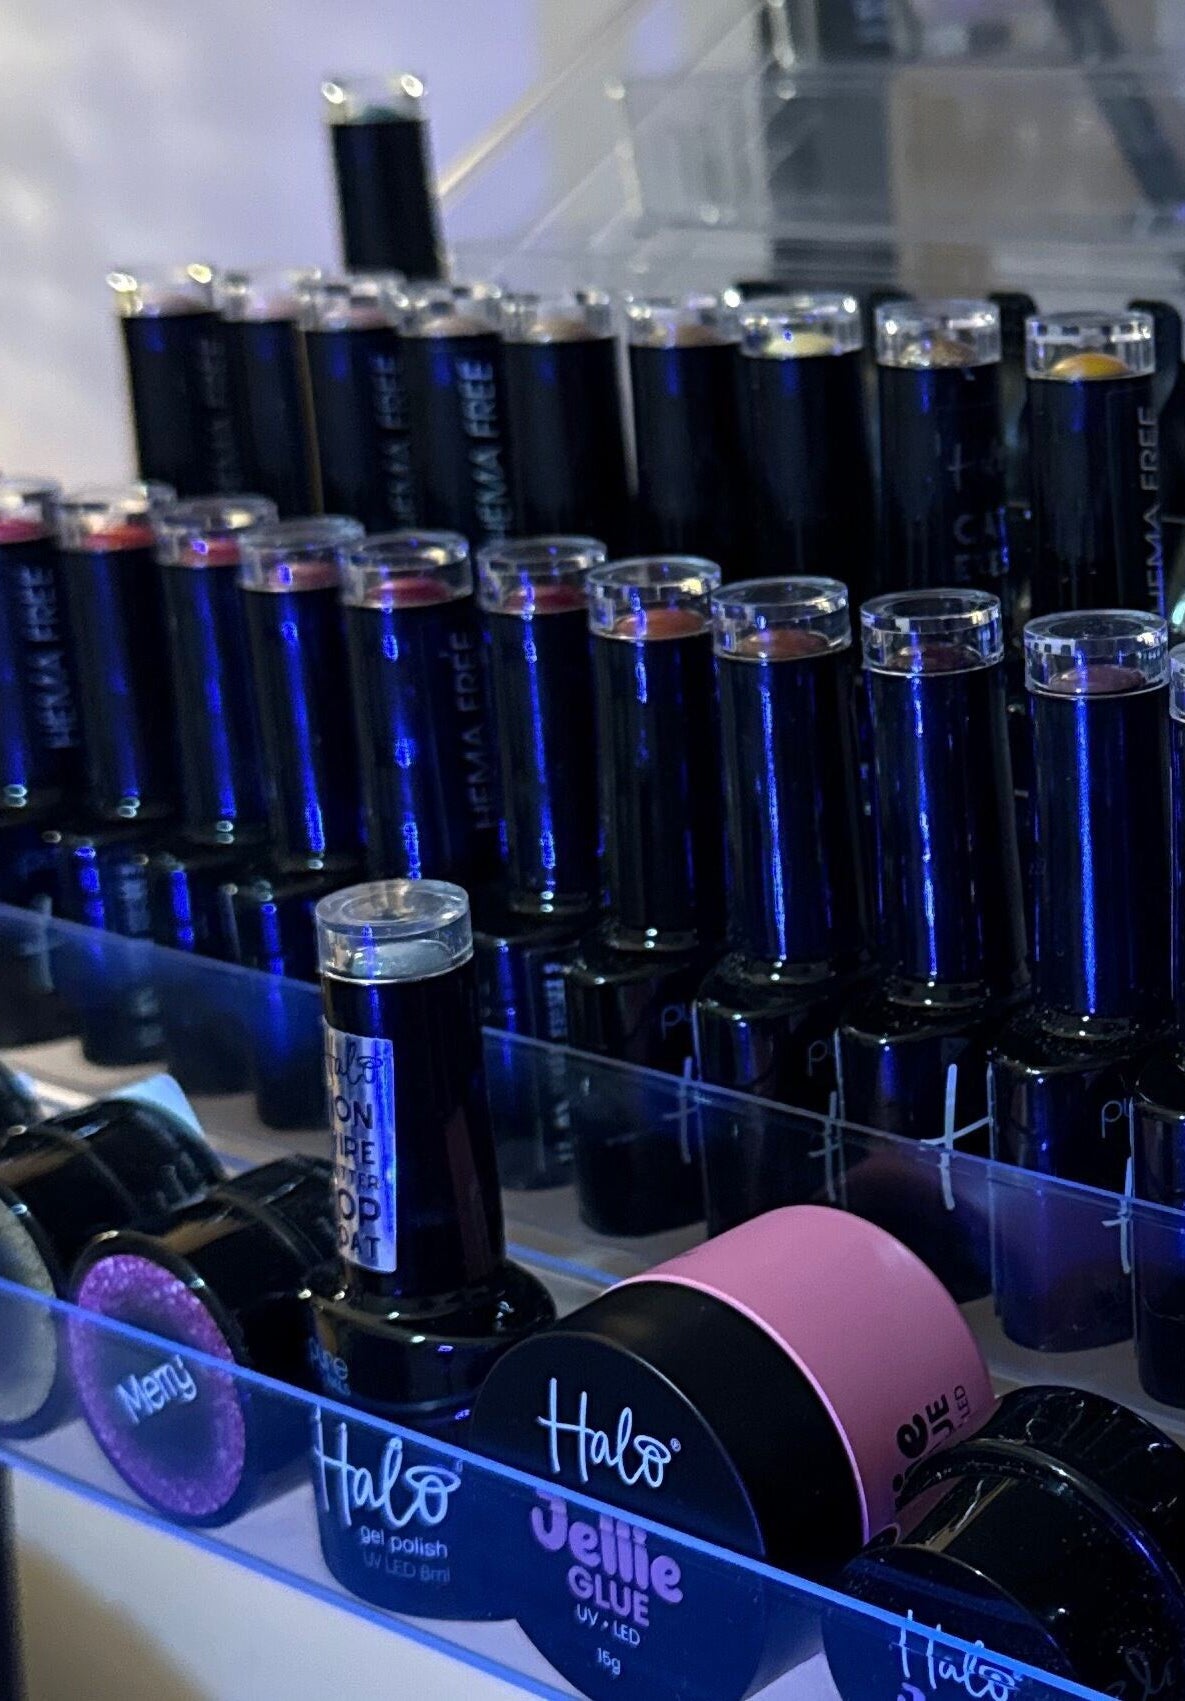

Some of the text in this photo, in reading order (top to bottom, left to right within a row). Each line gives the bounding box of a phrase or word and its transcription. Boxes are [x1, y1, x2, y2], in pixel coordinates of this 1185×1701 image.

[1136, 405, 1158, 491] FREE
[115, 1353, 198, 1425] Merry
[311, 1405, 461, 1528] Halo
[534, 1377, 670, 1489] Halo
[360, 1525, 448, 1560] gel polish
[529, 1487, 682, 1605] Jellie
[566, 1564, 649, 1628] GLUE
[576, 1603, 641, 1647] UV LED
[596, 1647, 621, 1676] 15g
